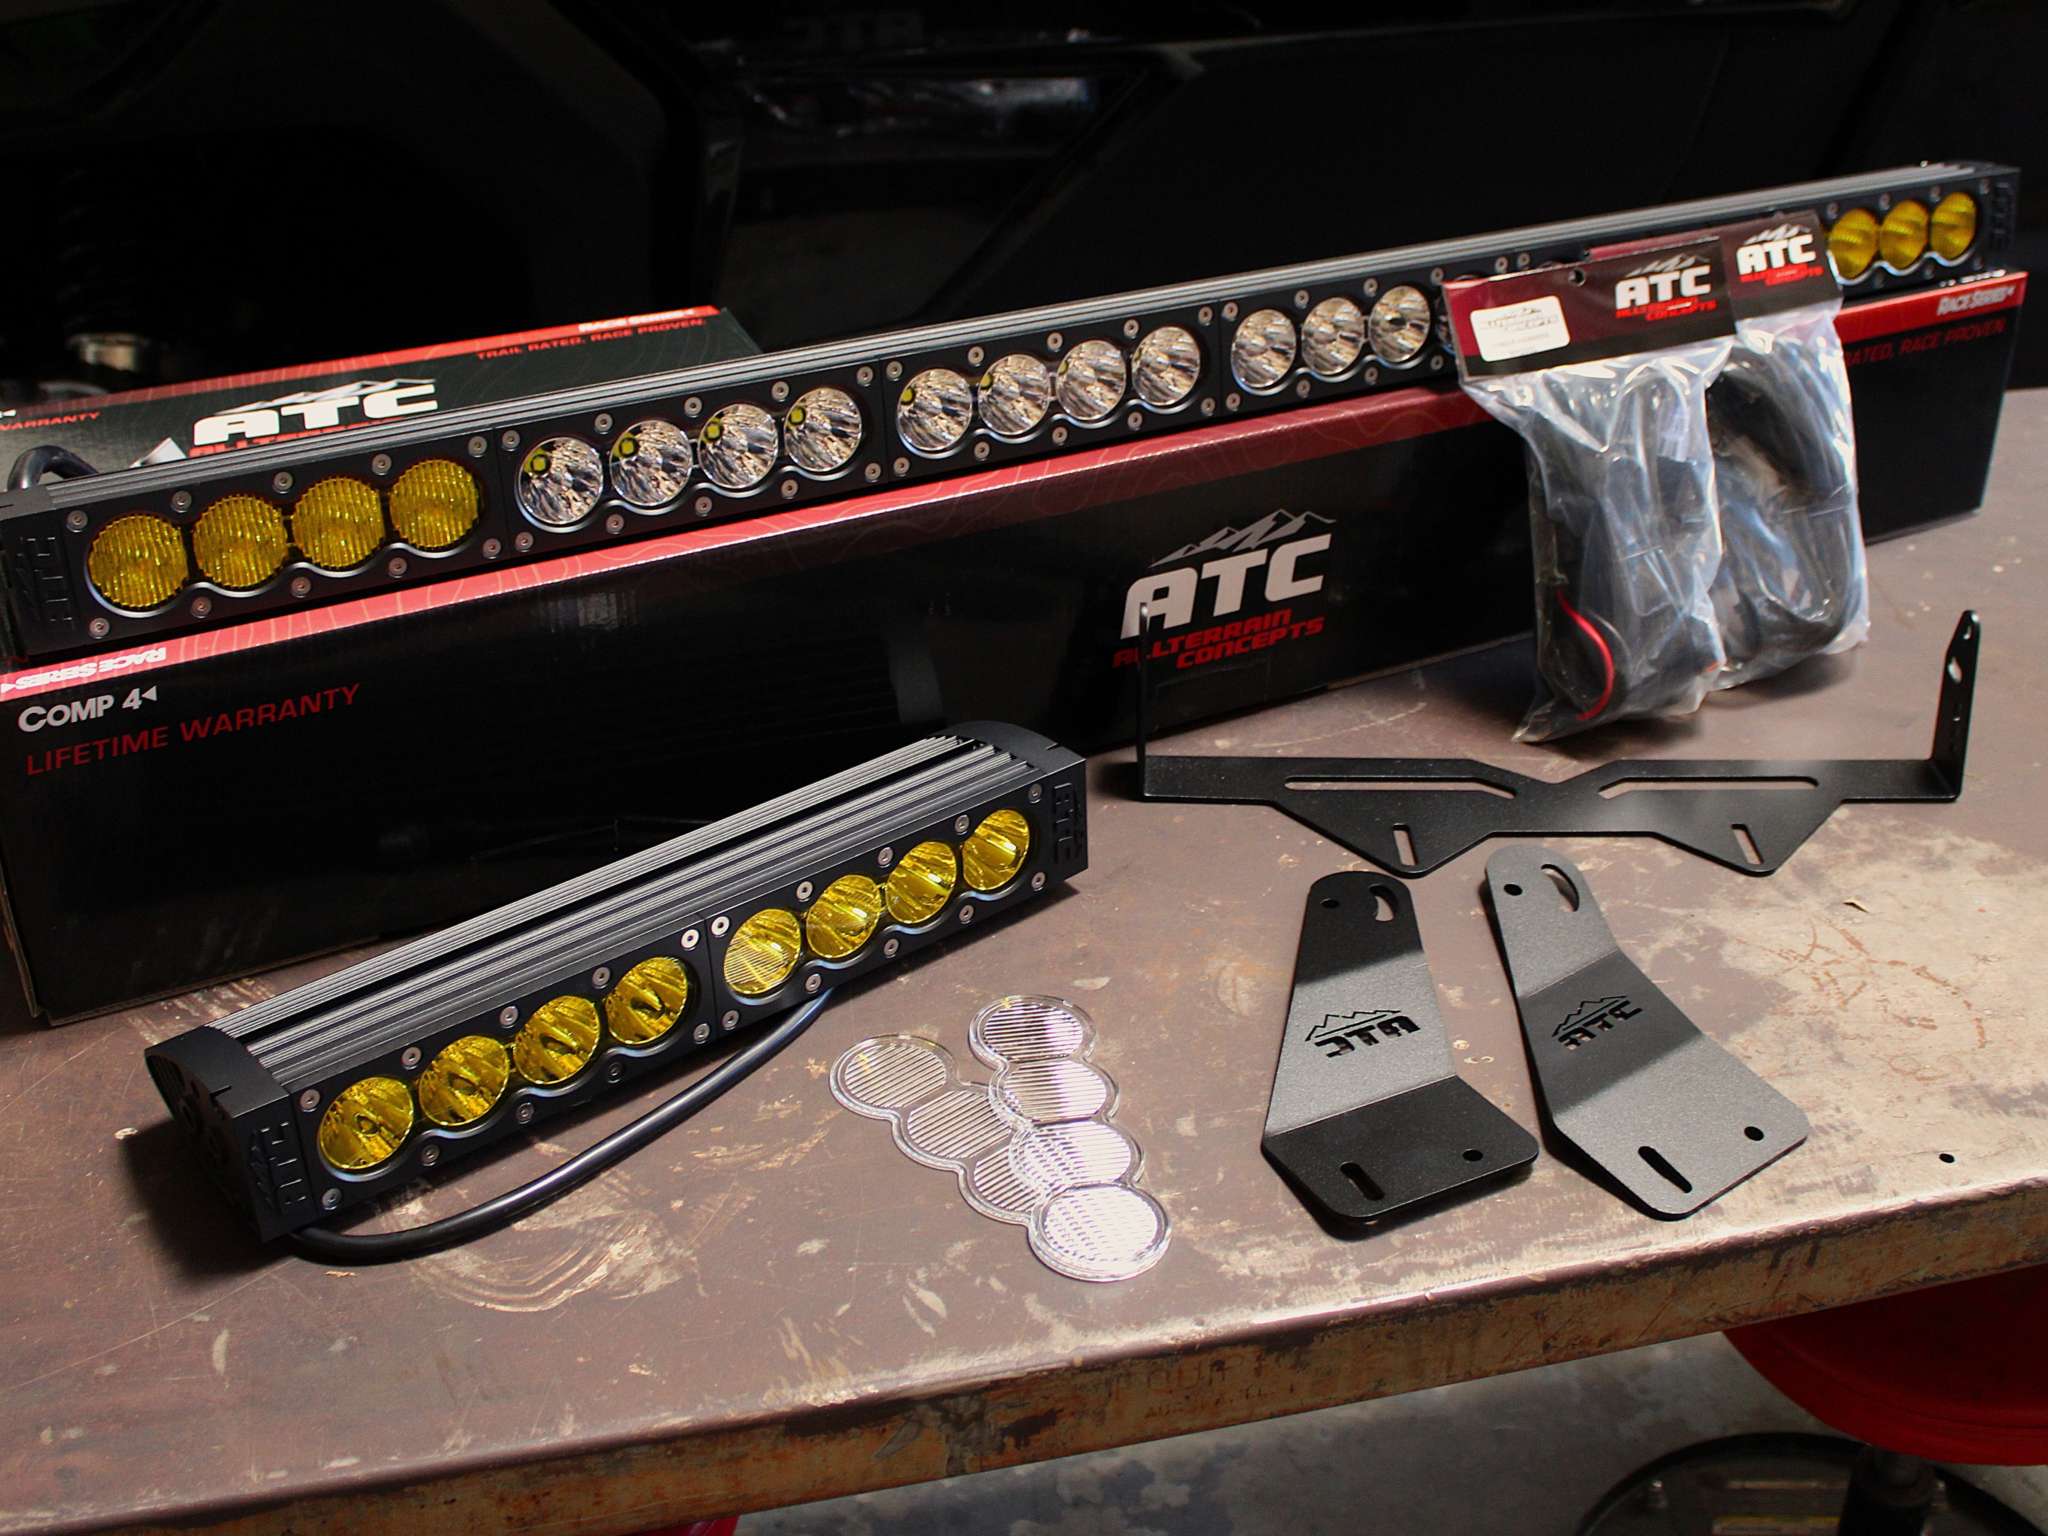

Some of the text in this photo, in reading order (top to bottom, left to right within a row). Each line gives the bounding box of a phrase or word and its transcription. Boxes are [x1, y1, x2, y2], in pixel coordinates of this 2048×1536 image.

[1736, 234, 1816, 275] ATC
[1615, 265, 1711, 310] ATC
[193, 383, 439, 446] ATC
[1121, 533, 1331, 640] ATC
[1176, 616, 1325, 670] CONCEPTS
[18, 694, 115, 733] COMP
[26, 683, 360, 776] LIFETIME WARRANTY
